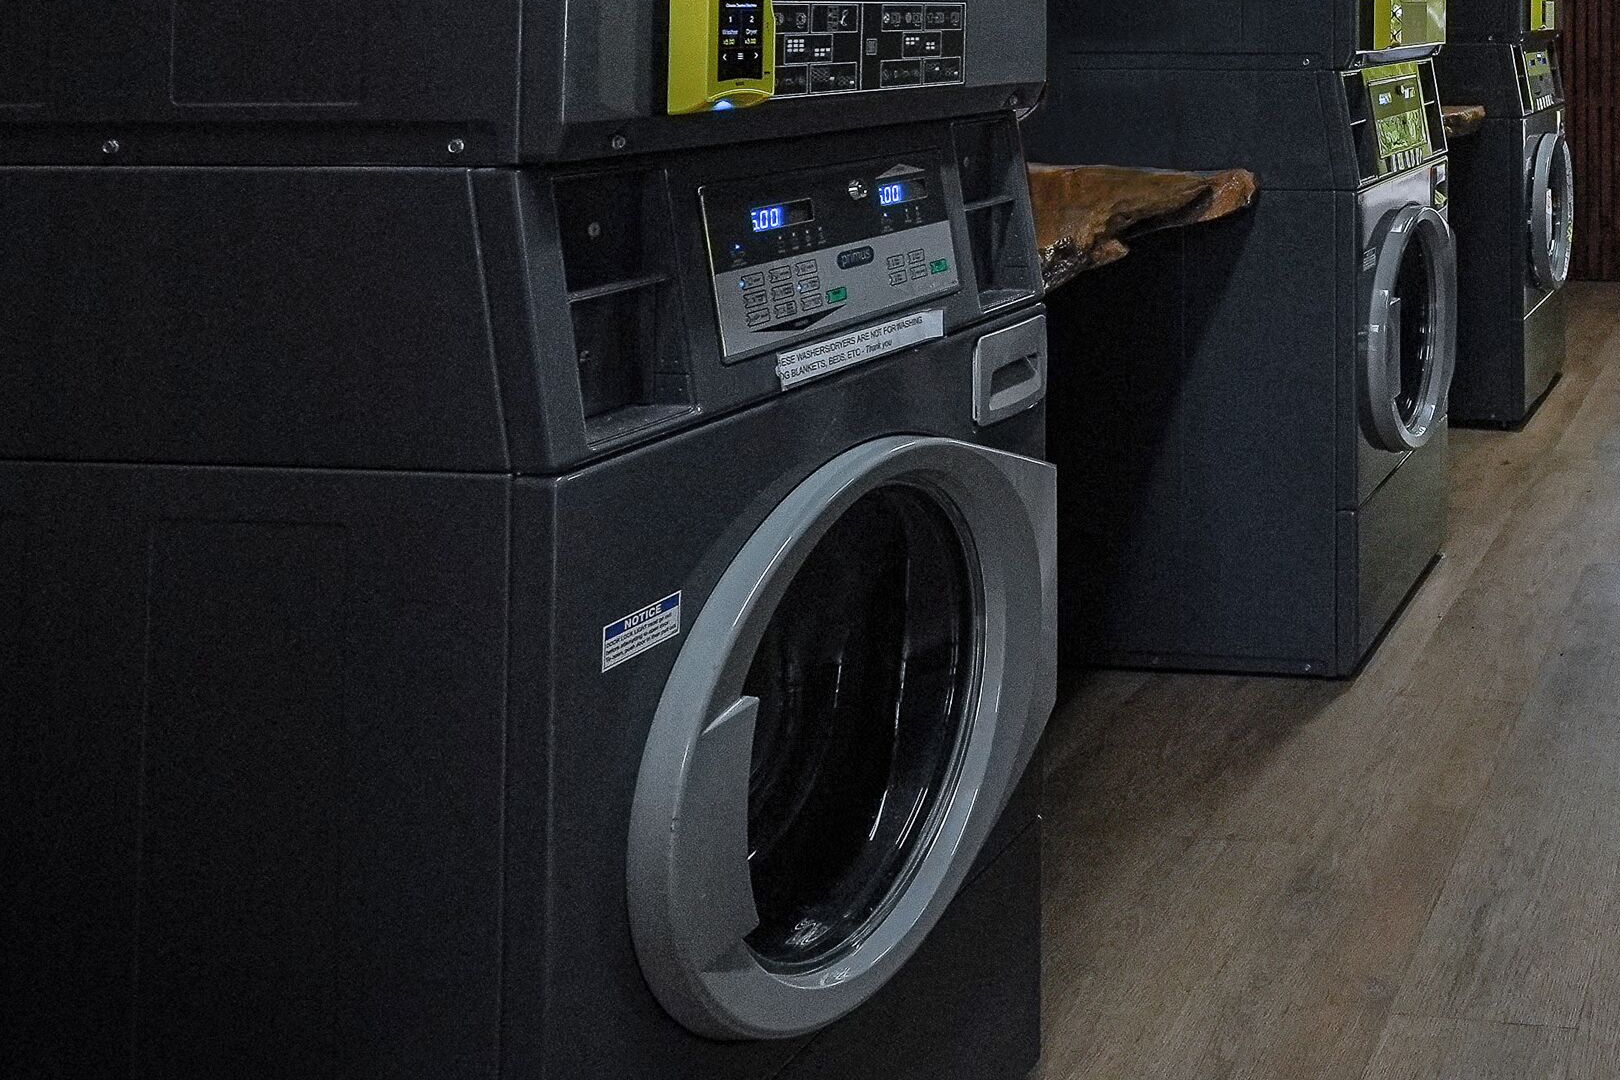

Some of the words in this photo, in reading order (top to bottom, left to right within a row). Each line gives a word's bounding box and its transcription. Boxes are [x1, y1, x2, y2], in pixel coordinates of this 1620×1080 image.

[749, 15, 754, 23] 2
[857, 332, 870, 343] ARE
[870, 328, 882, 337] NOT
[884, 325, 896, 335] FOR
[882, 340, 893, 349] you
[624, 604, 662, 630] NOTICE
